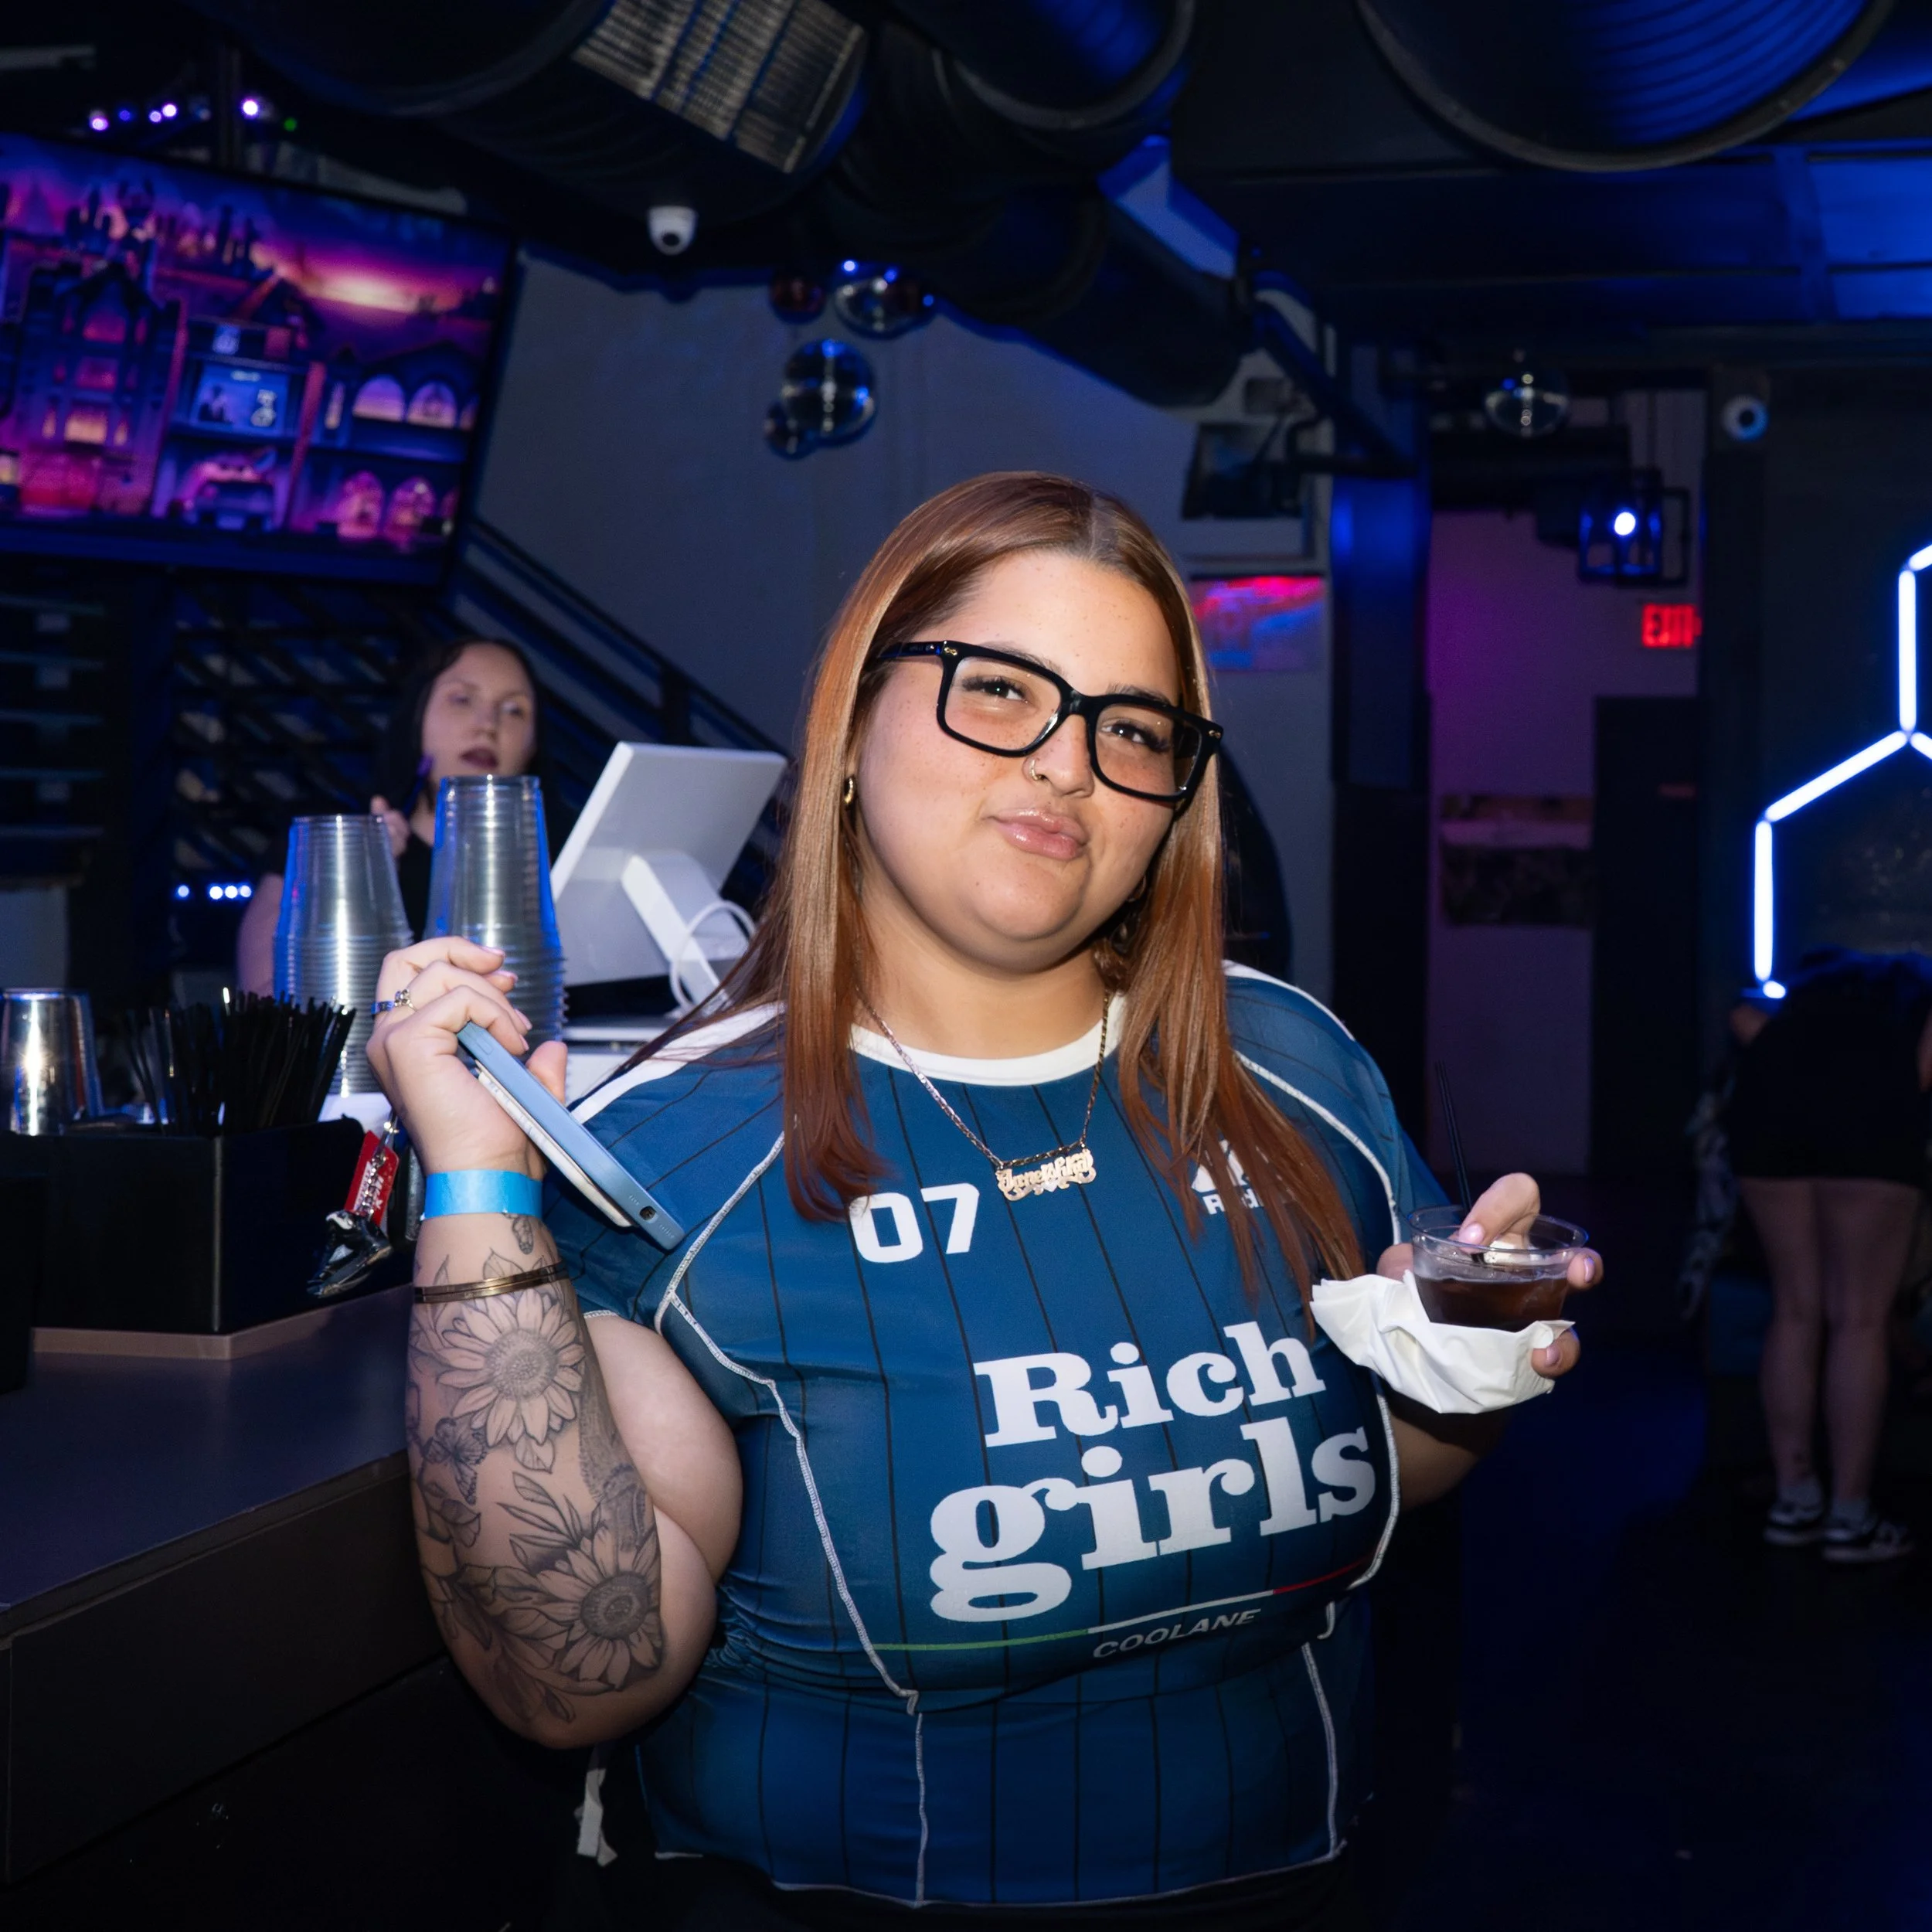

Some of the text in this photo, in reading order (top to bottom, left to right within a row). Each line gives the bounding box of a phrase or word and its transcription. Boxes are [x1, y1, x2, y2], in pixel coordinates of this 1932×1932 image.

[850, 1182, 980, 1263] 07
[973, 1321, 1325, 1447] Rich
[930, 1417, 1376, 1623] girls
[1093, 1608, 1262, 1658] COOLANE
